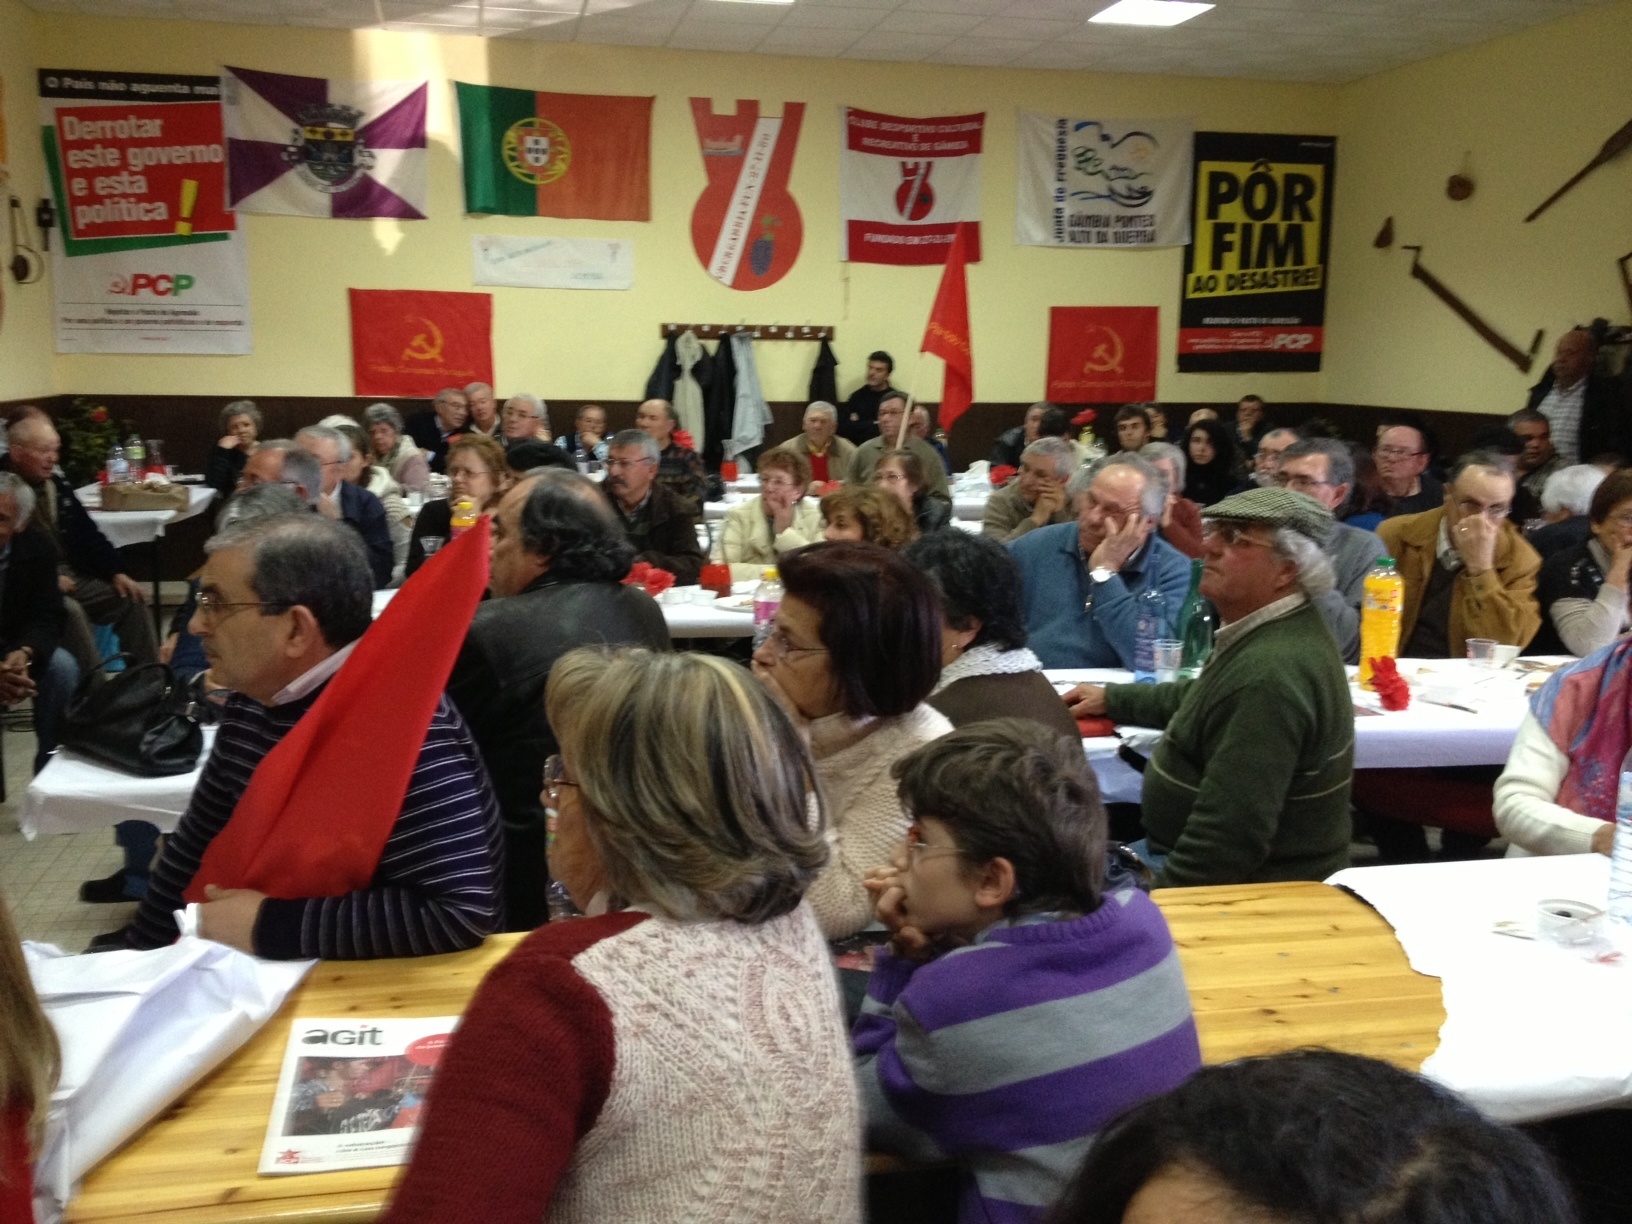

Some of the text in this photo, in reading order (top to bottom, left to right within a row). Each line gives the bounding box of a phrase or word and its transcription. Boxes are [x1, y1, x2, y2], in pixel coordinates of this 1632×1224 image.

[44, 76, 59, 88] O
[62, 115, 164, 140] Derrotar
[66, 144, 224, 171] este governo
[71, 171, 148, 196] e esta
[1206, 158, 1316, 222] PÔR
[75, 197, 169, 229] política
[1211, 222, 1305, 271] FIM
[131, 274, 195, 296] PCP
[1192, 268, 1320, 294] AO DESASTRE!
[1273, 333, 1315, 349] PCP
